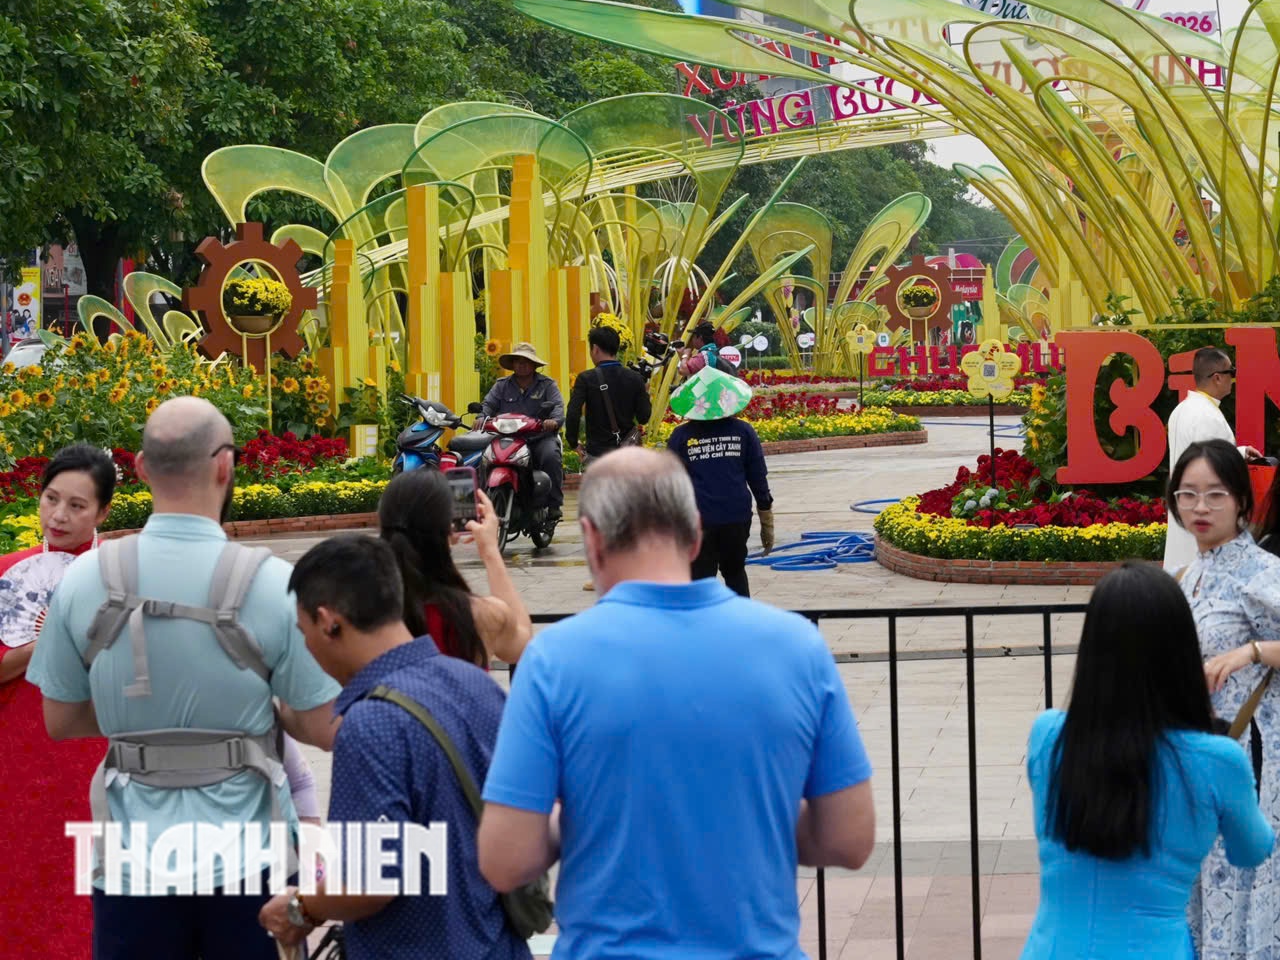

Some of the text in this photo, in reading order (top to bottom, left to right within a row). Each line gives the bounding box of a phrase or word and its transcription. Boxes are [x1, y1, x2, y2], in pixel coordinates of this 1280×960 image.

[954, 284, 980, 297] Malaysia
[688, 442, 741, 455] CÔNG VIÊN CÂY XANH
[711, 450, 723, 458] CHÍ
